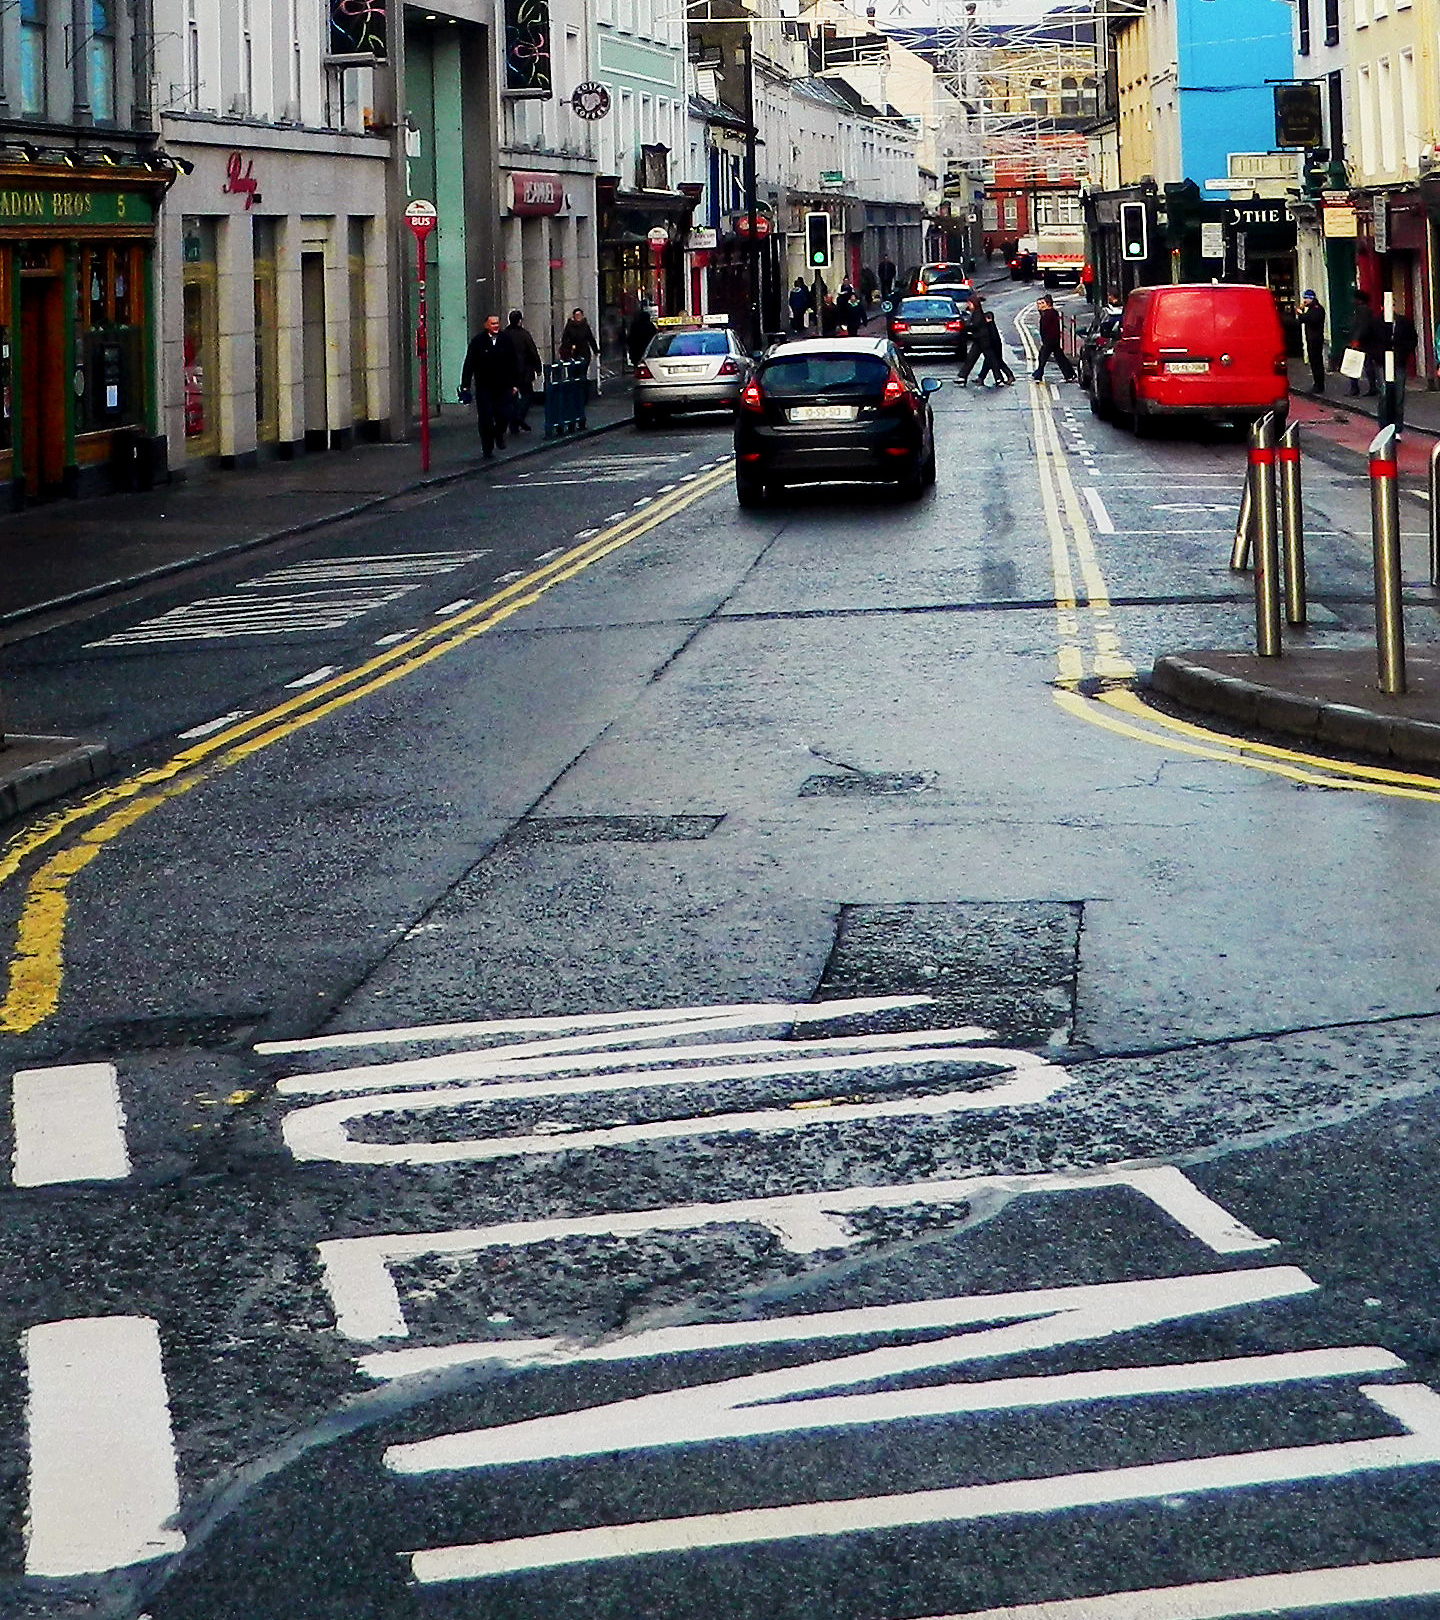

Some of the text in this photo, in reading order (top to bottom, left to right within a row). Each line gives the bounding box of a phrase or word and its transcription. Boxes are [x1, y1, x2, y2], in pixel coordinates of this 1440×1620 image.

[53, 192, 92, 218] BROS
[117, 194, 126, 218] 5
[411, 216, 431, 226] BUS
[1243, 209, 1280, 223] THE
